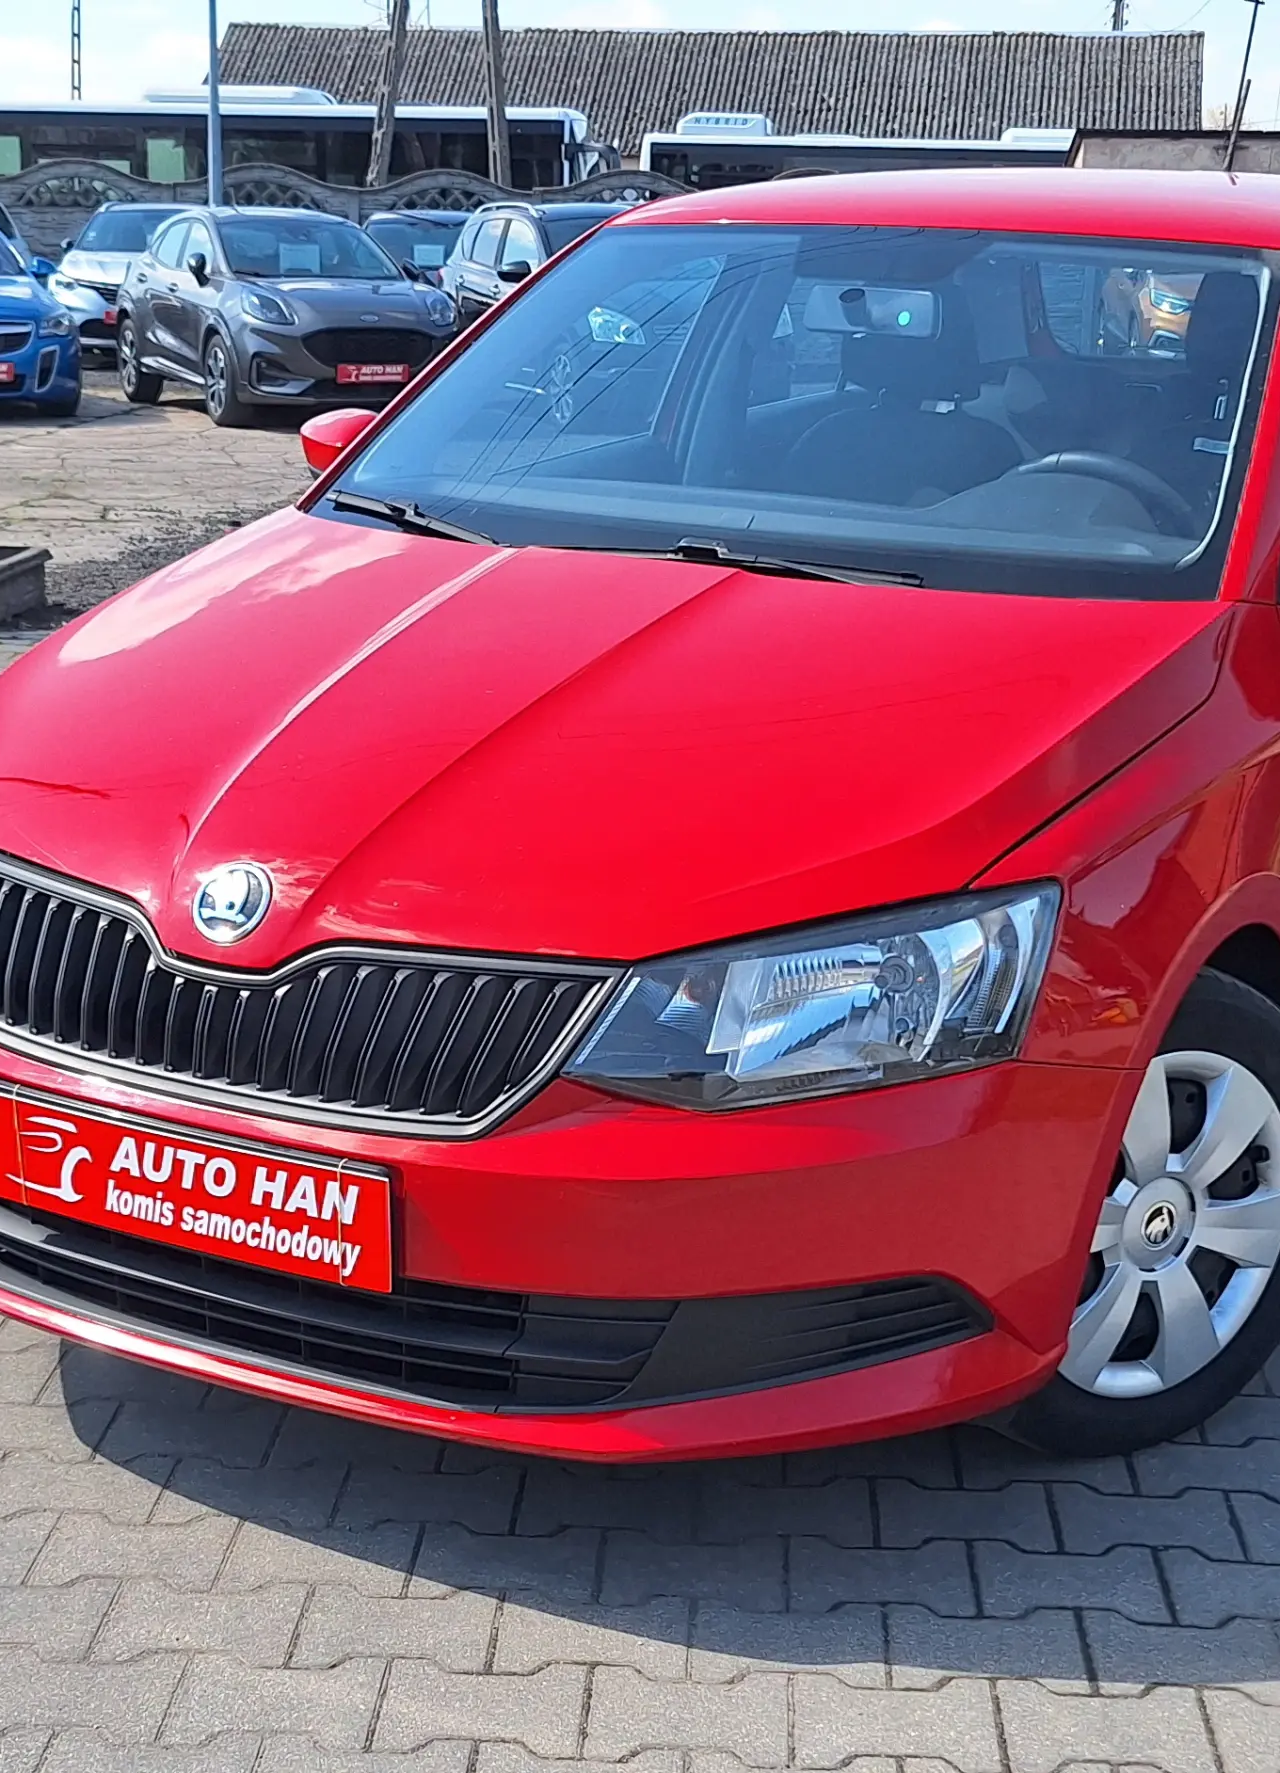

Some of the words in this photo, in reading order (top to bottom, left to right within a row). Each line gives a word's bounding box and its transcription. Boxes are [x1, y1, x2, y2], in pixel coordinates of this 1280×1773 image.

[105, 1179, 175, 1227] komis
[180, 1206, 362, 1277] samochodowy
[109, 1136, 237, 1198] AUTO
[250, 1166, 361, 1226] HAN
